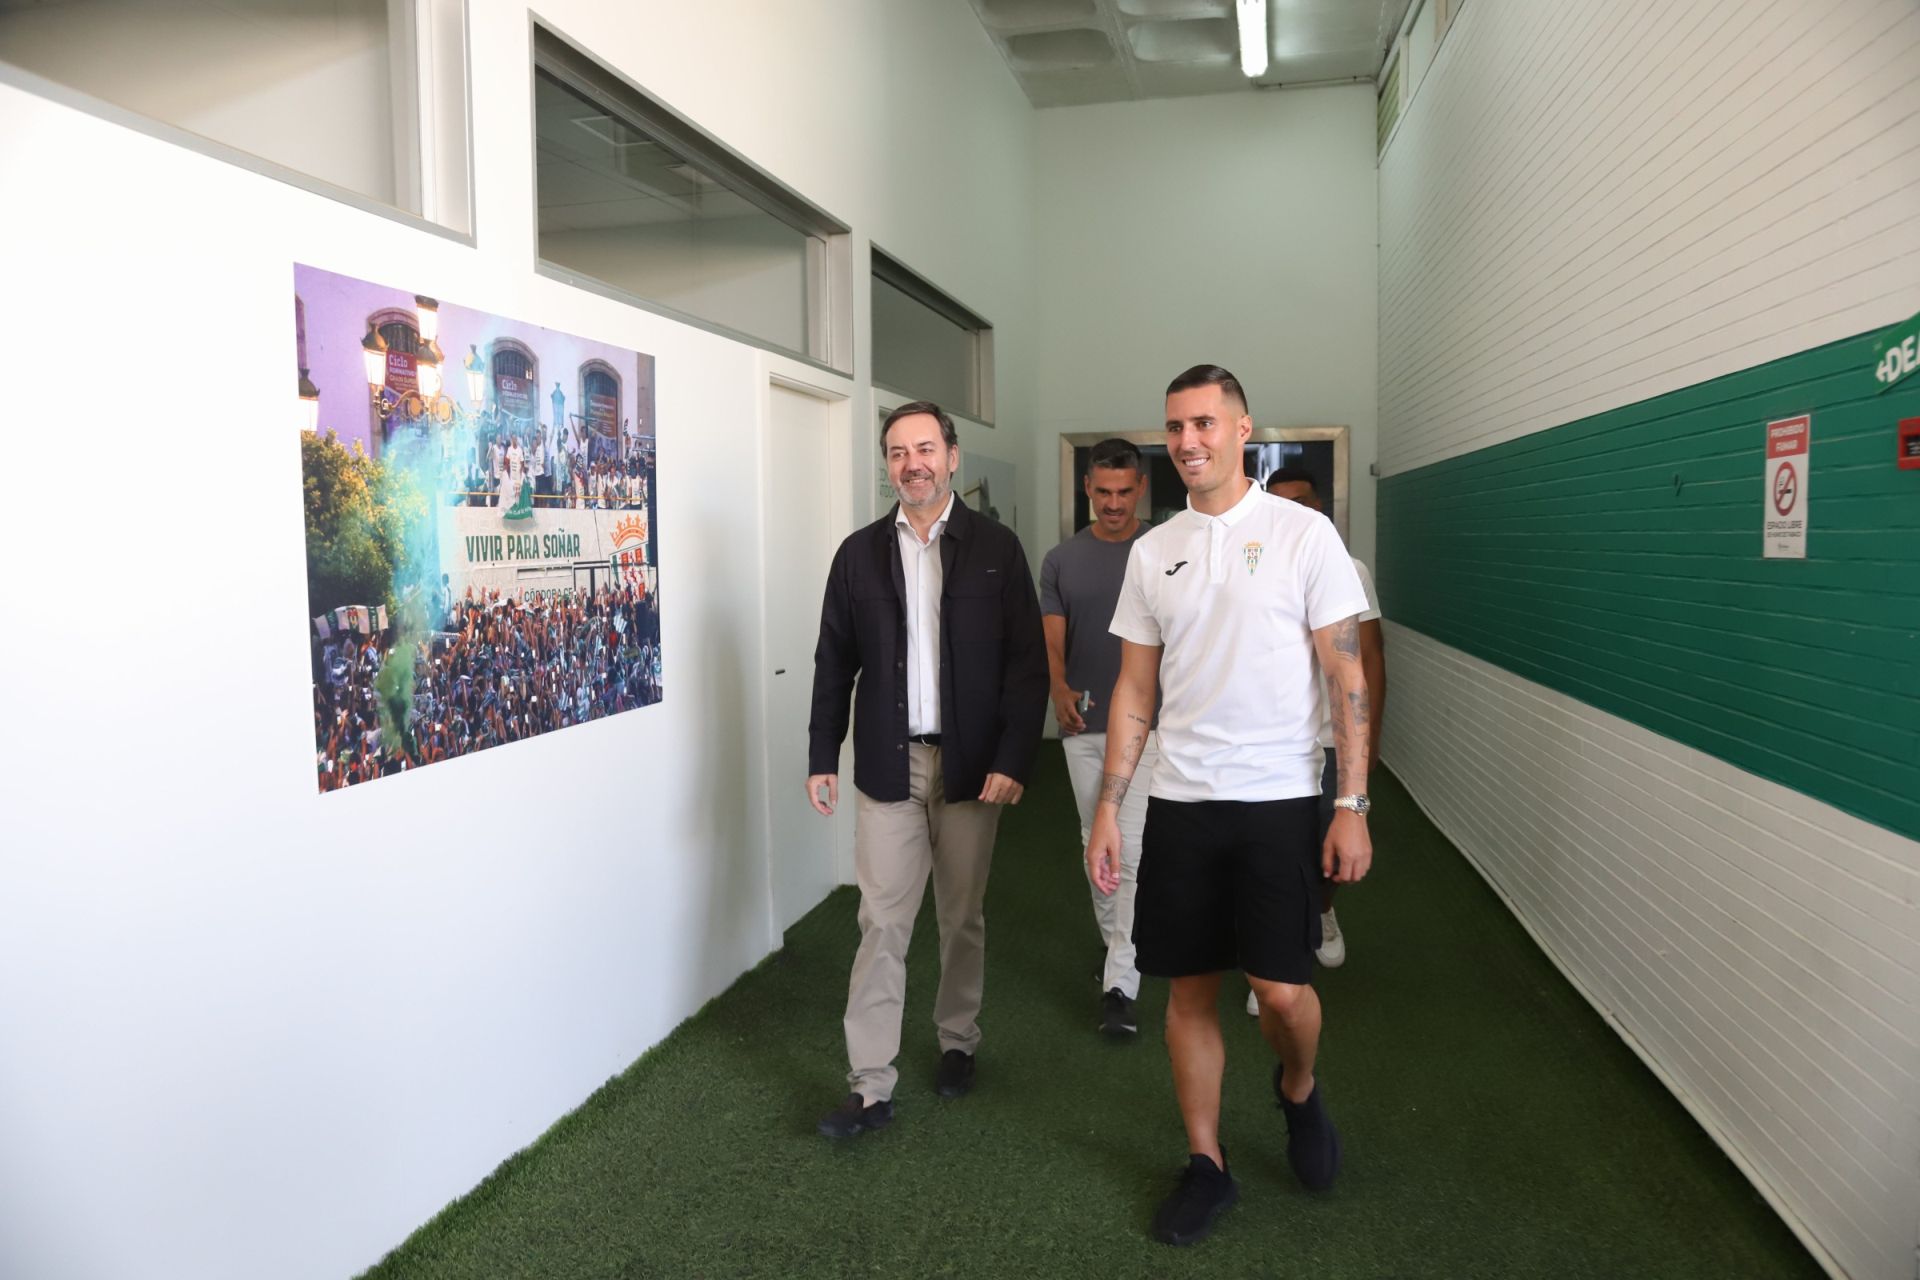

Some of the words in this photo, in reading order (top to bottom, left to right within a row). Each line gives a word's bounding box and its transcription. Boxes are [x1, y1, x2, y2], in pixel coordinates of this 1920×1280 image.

[388, 354, 408, 368] Ciclo
[1885, 330, 1920, 383] DE
[1770, 423, 1804, 438] PROHIBIDO
[1775, 440, 1798, 452] FUMAR
[466, 534, 503, 563] VIVIR
[507, 534, 540, 561] PARA
[543, 527, 581, 558] SOÑAR
